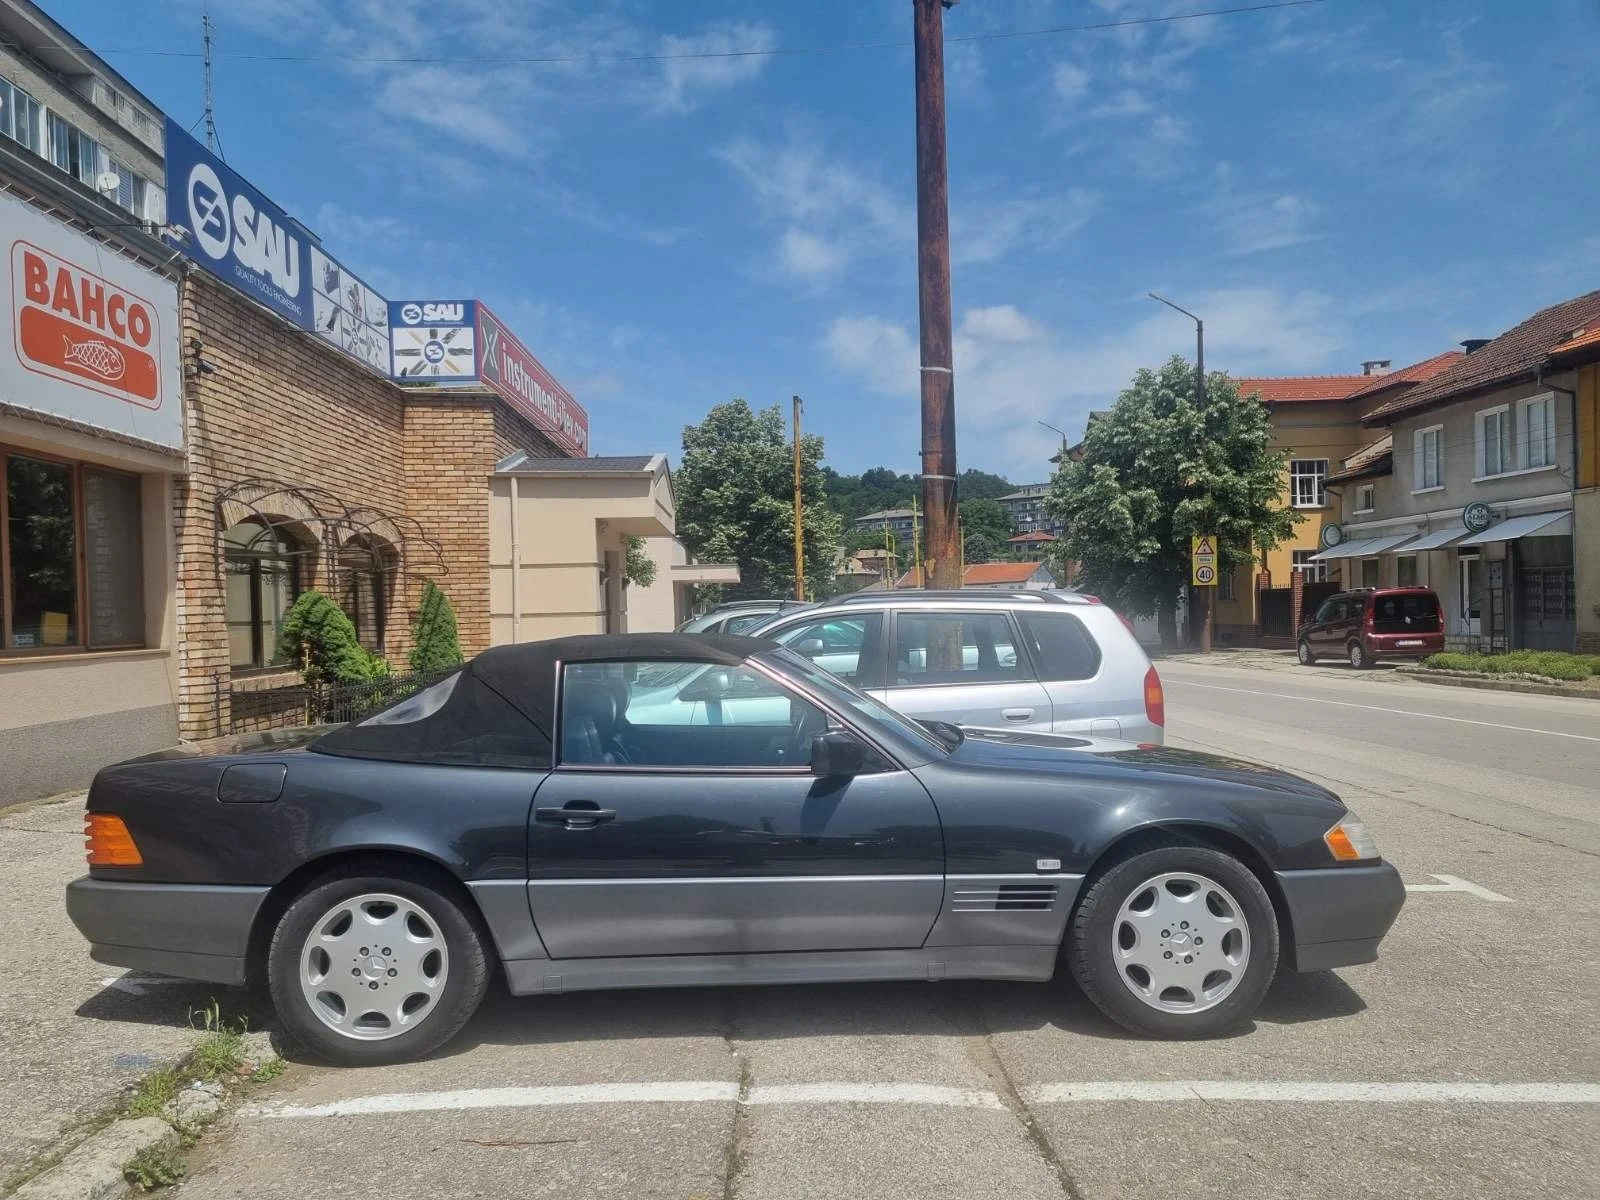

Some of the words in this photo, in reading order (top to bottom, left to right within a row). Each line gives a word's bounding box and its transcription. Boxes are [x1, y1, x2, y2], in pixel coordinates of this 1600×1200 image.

[233, 194, 300, 298] SAU
[24, 251, 152, 348] BAHCO
[423, 303, 464, 321] SAU
[1200, 570, 1211, 579] 40
